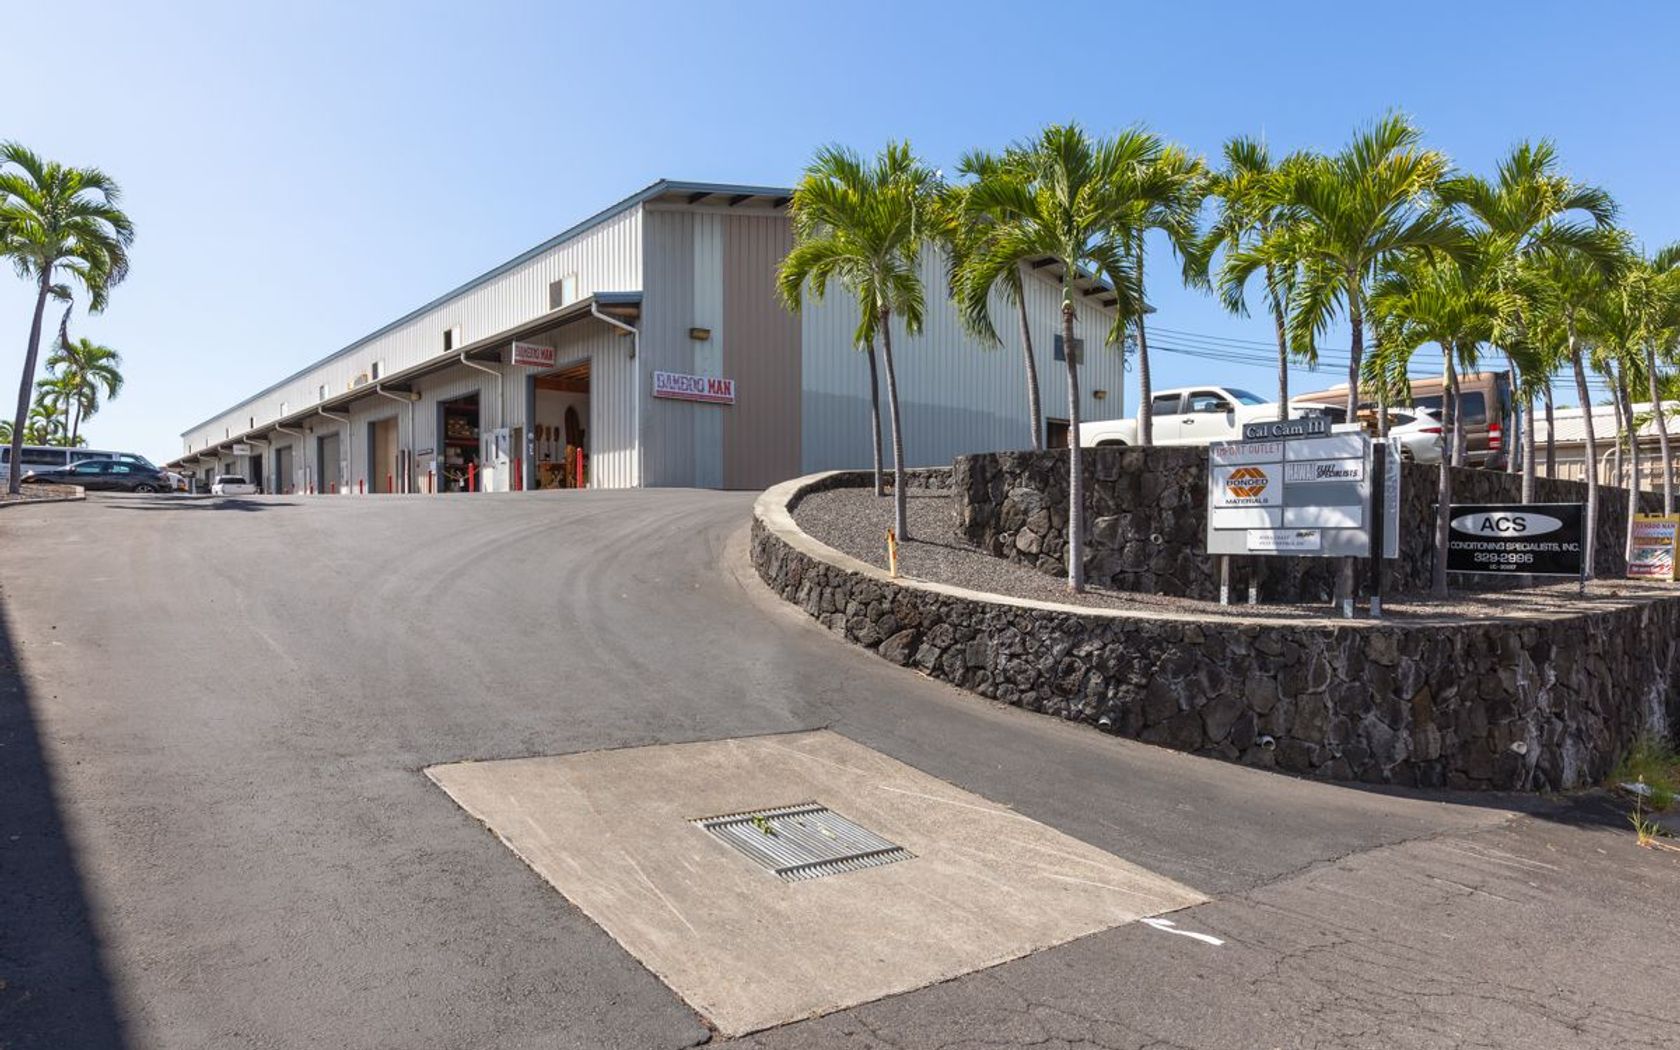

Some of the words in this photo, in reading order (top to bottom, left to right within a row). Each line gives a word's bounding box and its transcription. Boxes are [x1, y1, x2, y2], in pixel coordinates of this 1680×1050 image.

[540, 347, 554, 361] MAN
[656, 373, 705, 393] BAMBOO
[707, 378, 732, 396] MAN
[1246, 425, 1268, 439] Cal
[1272, 423, 1303, 437] Cam
[1480, 516, 1527, 532] ACS
[1450, 541, 1504, 550] CONDITIONING
[1562, 543, 1579, 552] INC.
[1474, 552, 1534, 563] 329-2996
